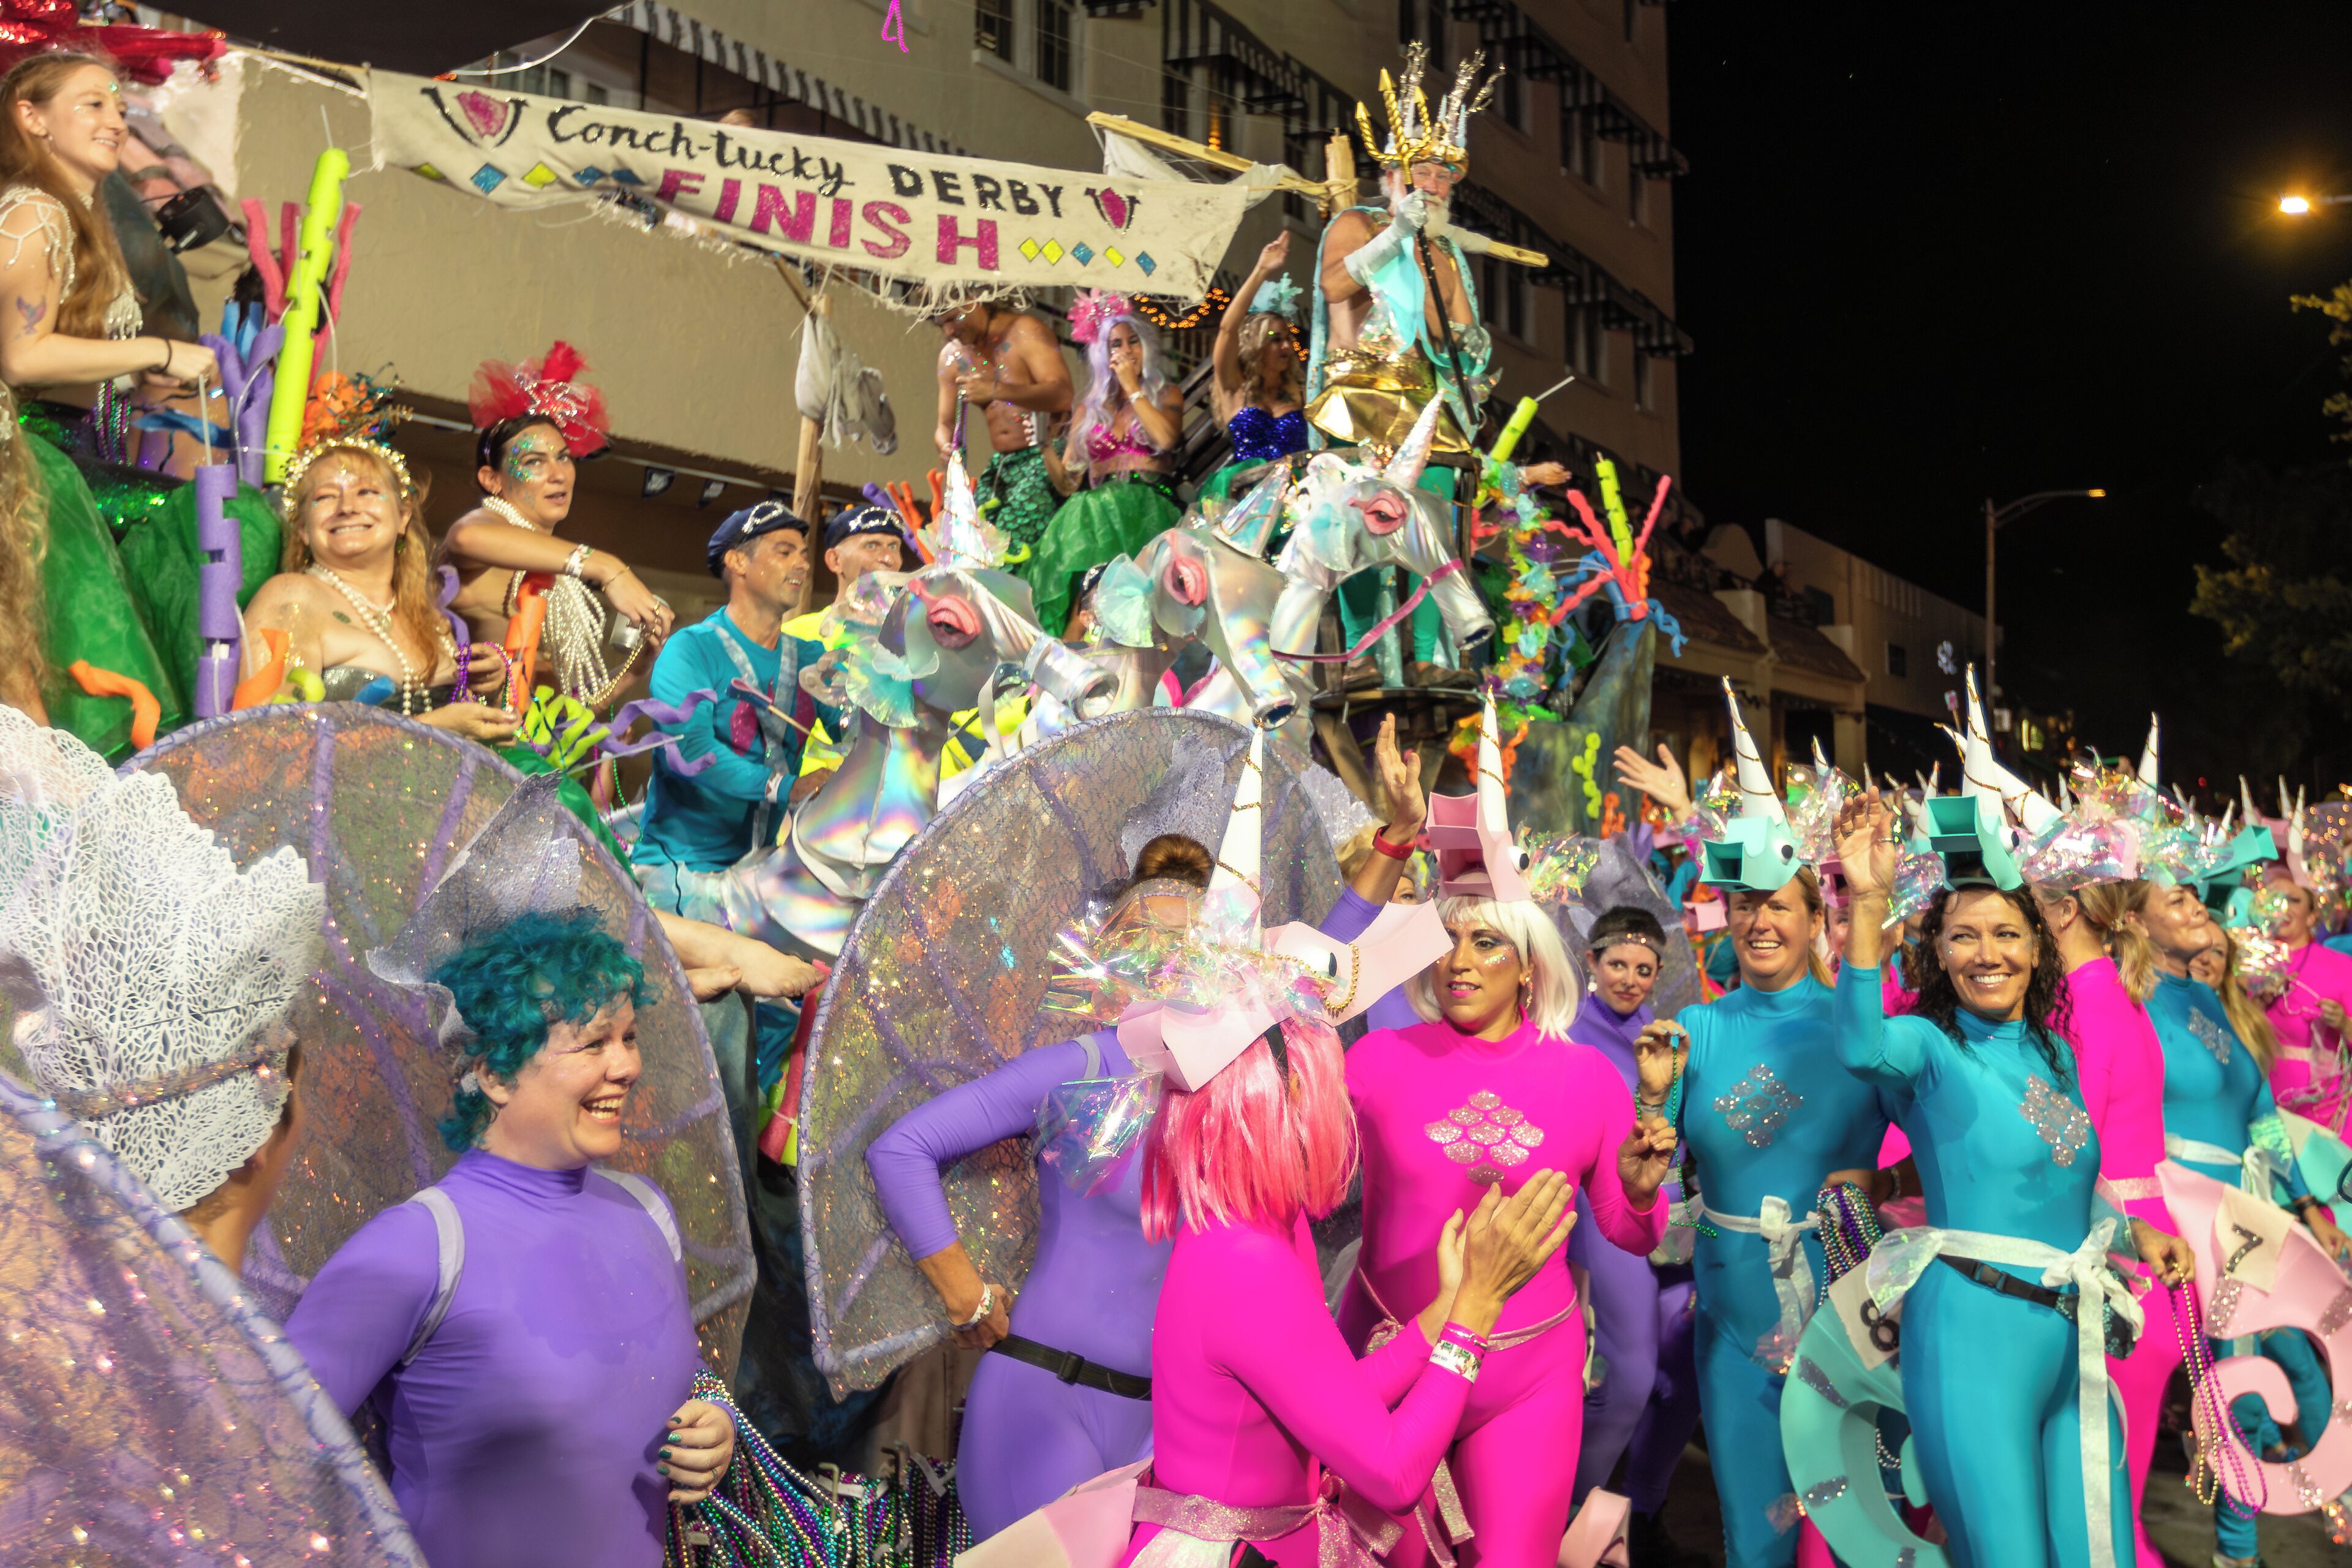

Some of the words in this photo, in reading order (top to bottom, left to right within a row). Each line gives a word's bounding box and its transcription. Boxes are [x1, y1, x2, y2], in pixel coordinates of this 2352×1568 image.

[546, 105, 855, 197] Conch-tucky
[886, 164, 1063, 218] DERBY
[656, 168, 999, 271] FINISH
[2226, 1222, 2263, 1273] 7
[1860, 1298, 1900, 1352] 8
